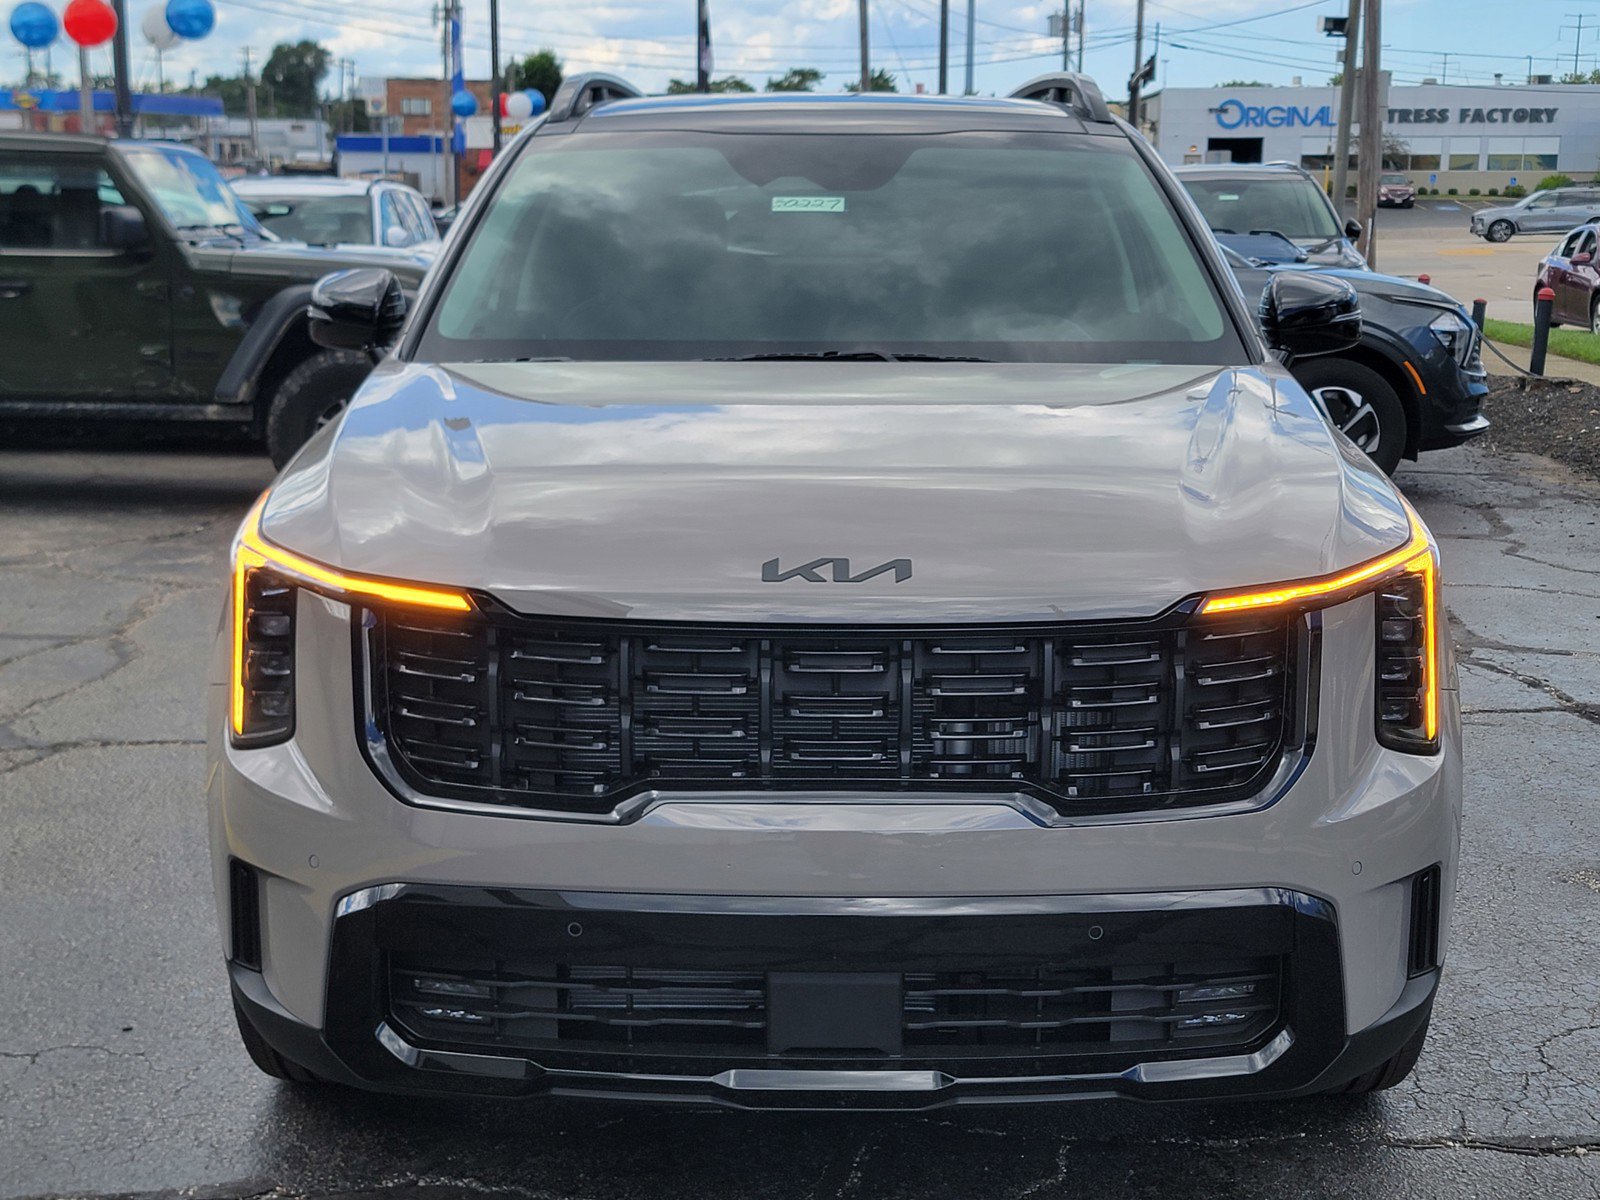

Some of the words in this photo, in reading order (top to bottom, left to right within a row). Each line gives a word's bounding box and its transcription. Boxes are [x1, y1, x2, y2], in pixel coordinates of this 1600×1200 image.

[1216, 99, 1337, 129] ORIGINAL
[1459, 108, 1559, 124] FACTORY
[761, 557, 912, 583] KIA
